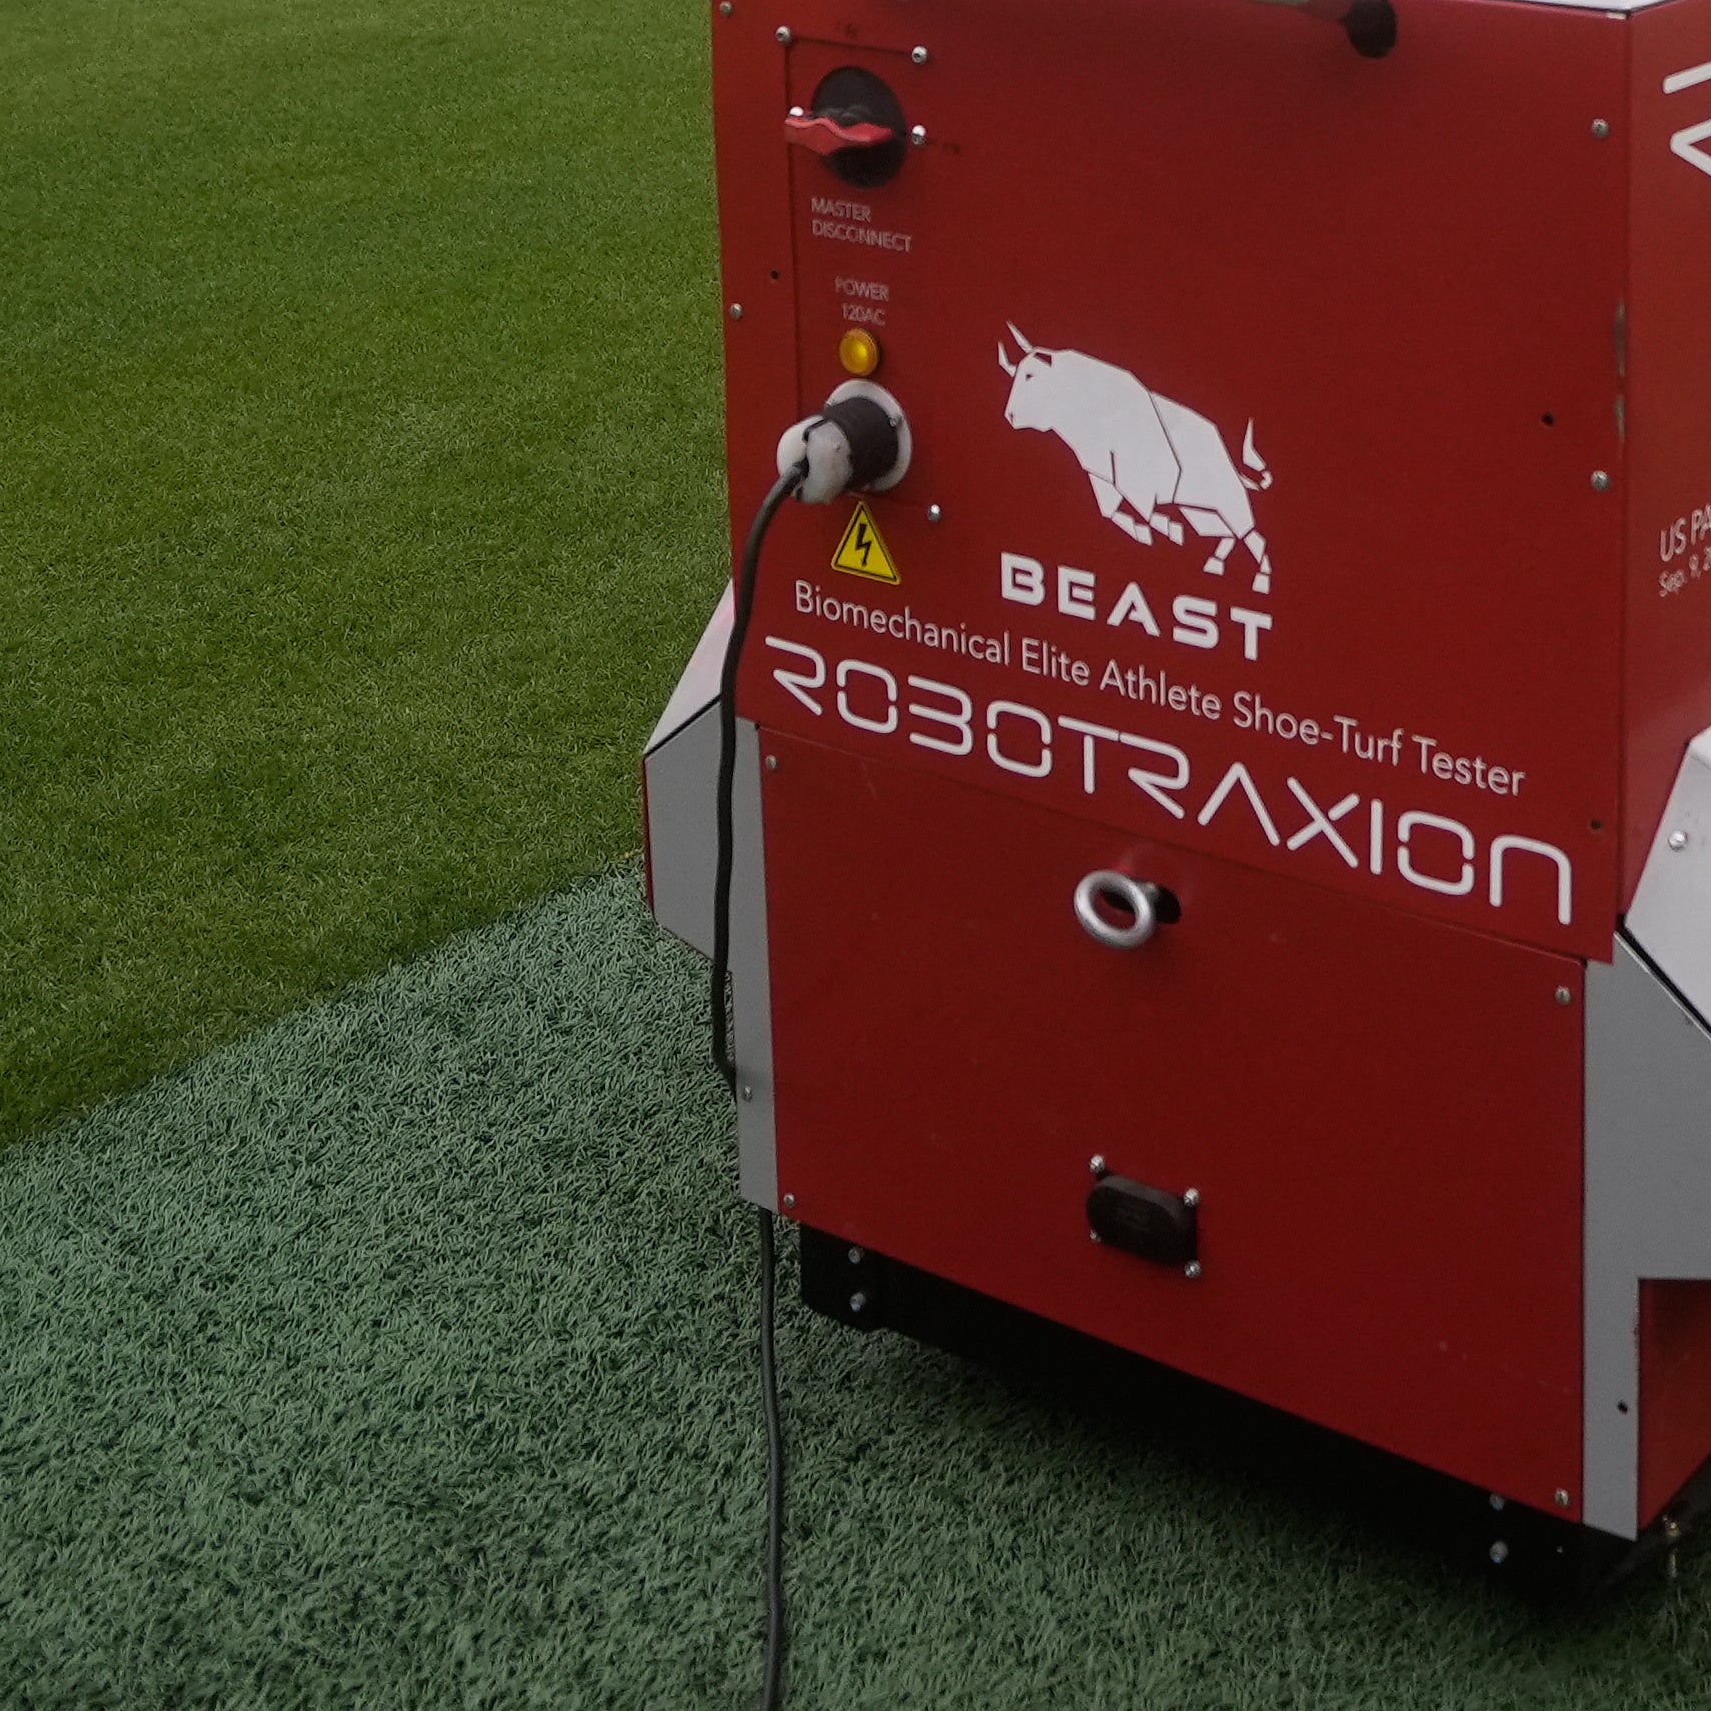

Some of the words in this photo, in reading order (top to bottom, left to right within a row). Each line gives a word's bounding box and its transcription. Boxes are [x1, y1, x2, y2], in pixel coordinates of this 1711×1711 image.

[811, 197, 872, 223] MASTER
[811, 220, 913, 252] DISCONNECT
[834, 277, 890, 302] POWER
[1659, 516, 1687, 563] US
[1000, 550, 1273, 661] BEAST
[794, 579, 1011, 666] Biomechanical
[1021, 636, 1090, 688] Elite
[1098, 658, 1222, 721] Athlete
[1232, 689, 1405, 767] Shoe-Turf
[1411, 734, 1528, 797] Tester
